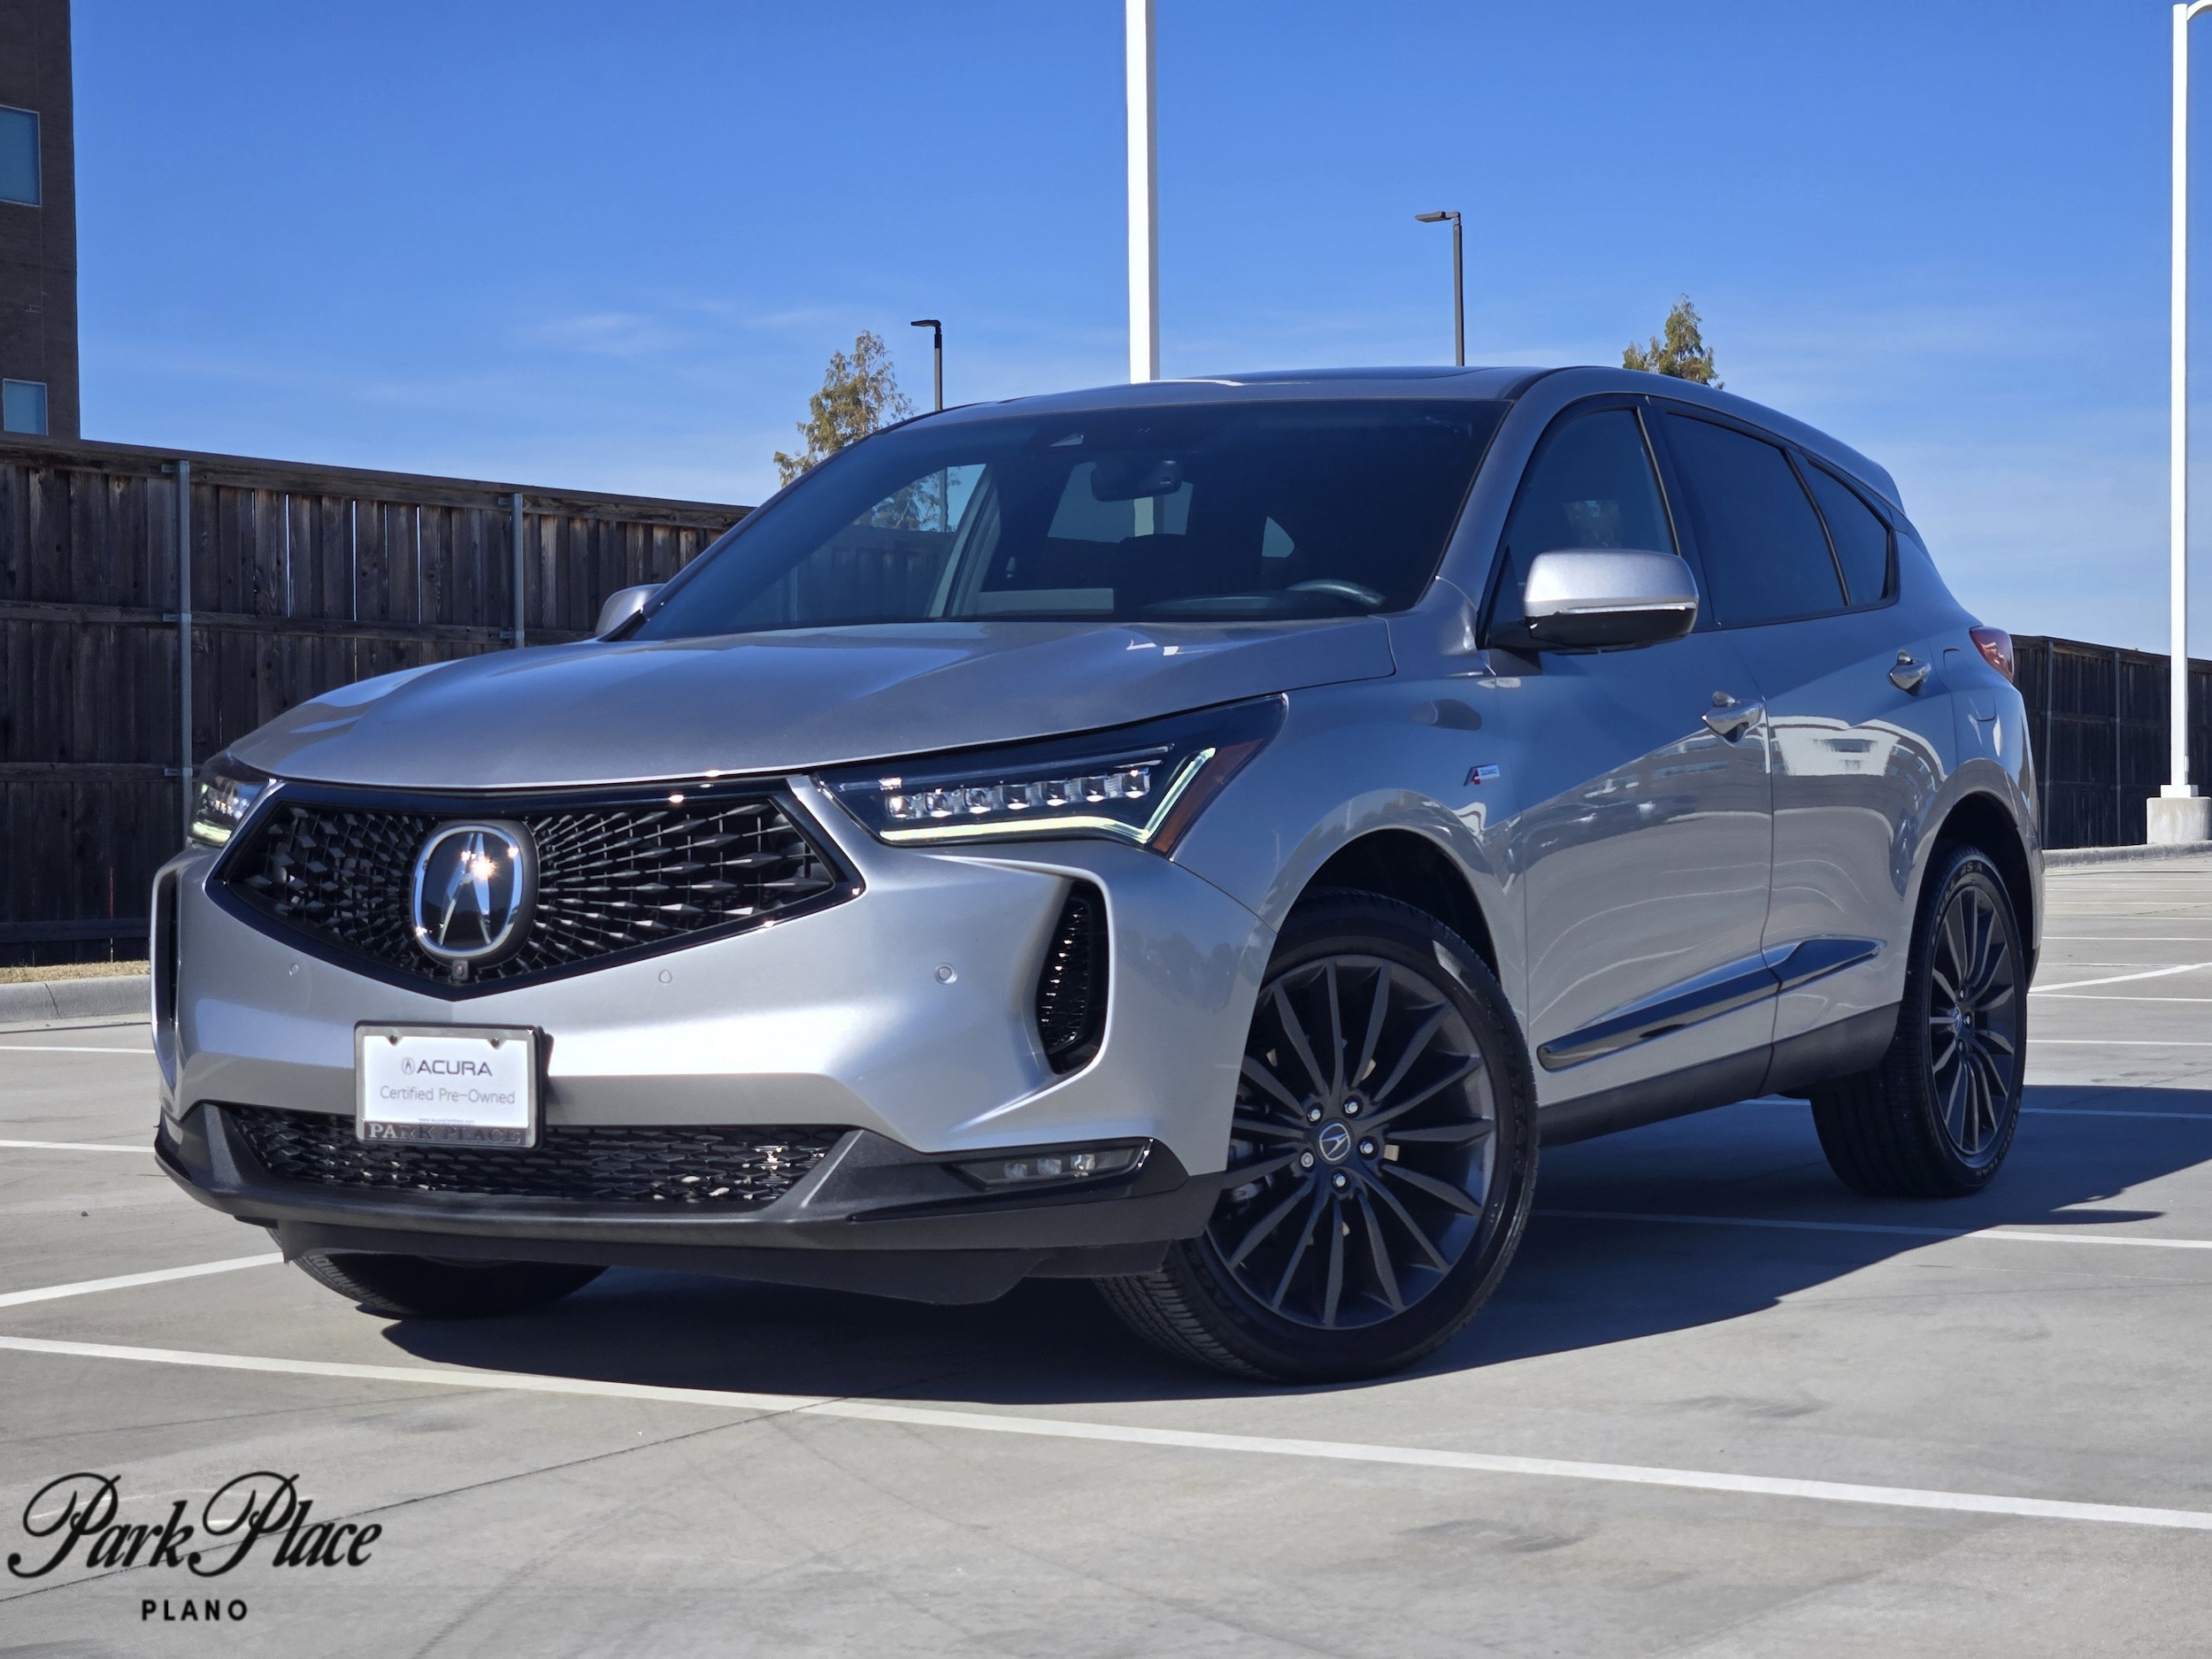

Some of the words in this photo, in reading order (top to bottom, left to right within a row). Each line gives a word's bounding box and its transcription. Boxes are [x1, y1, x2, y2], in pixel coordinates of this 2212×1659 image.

[417, 1059, 493, 1077] ACURA
[380, 1085, 434, 1101] Certified
[439, 1087, 516, 1104] Pre-Owned
[368, 1123, 435, 1141] PARK
[442, 1126, 521, 1145] PLACE
